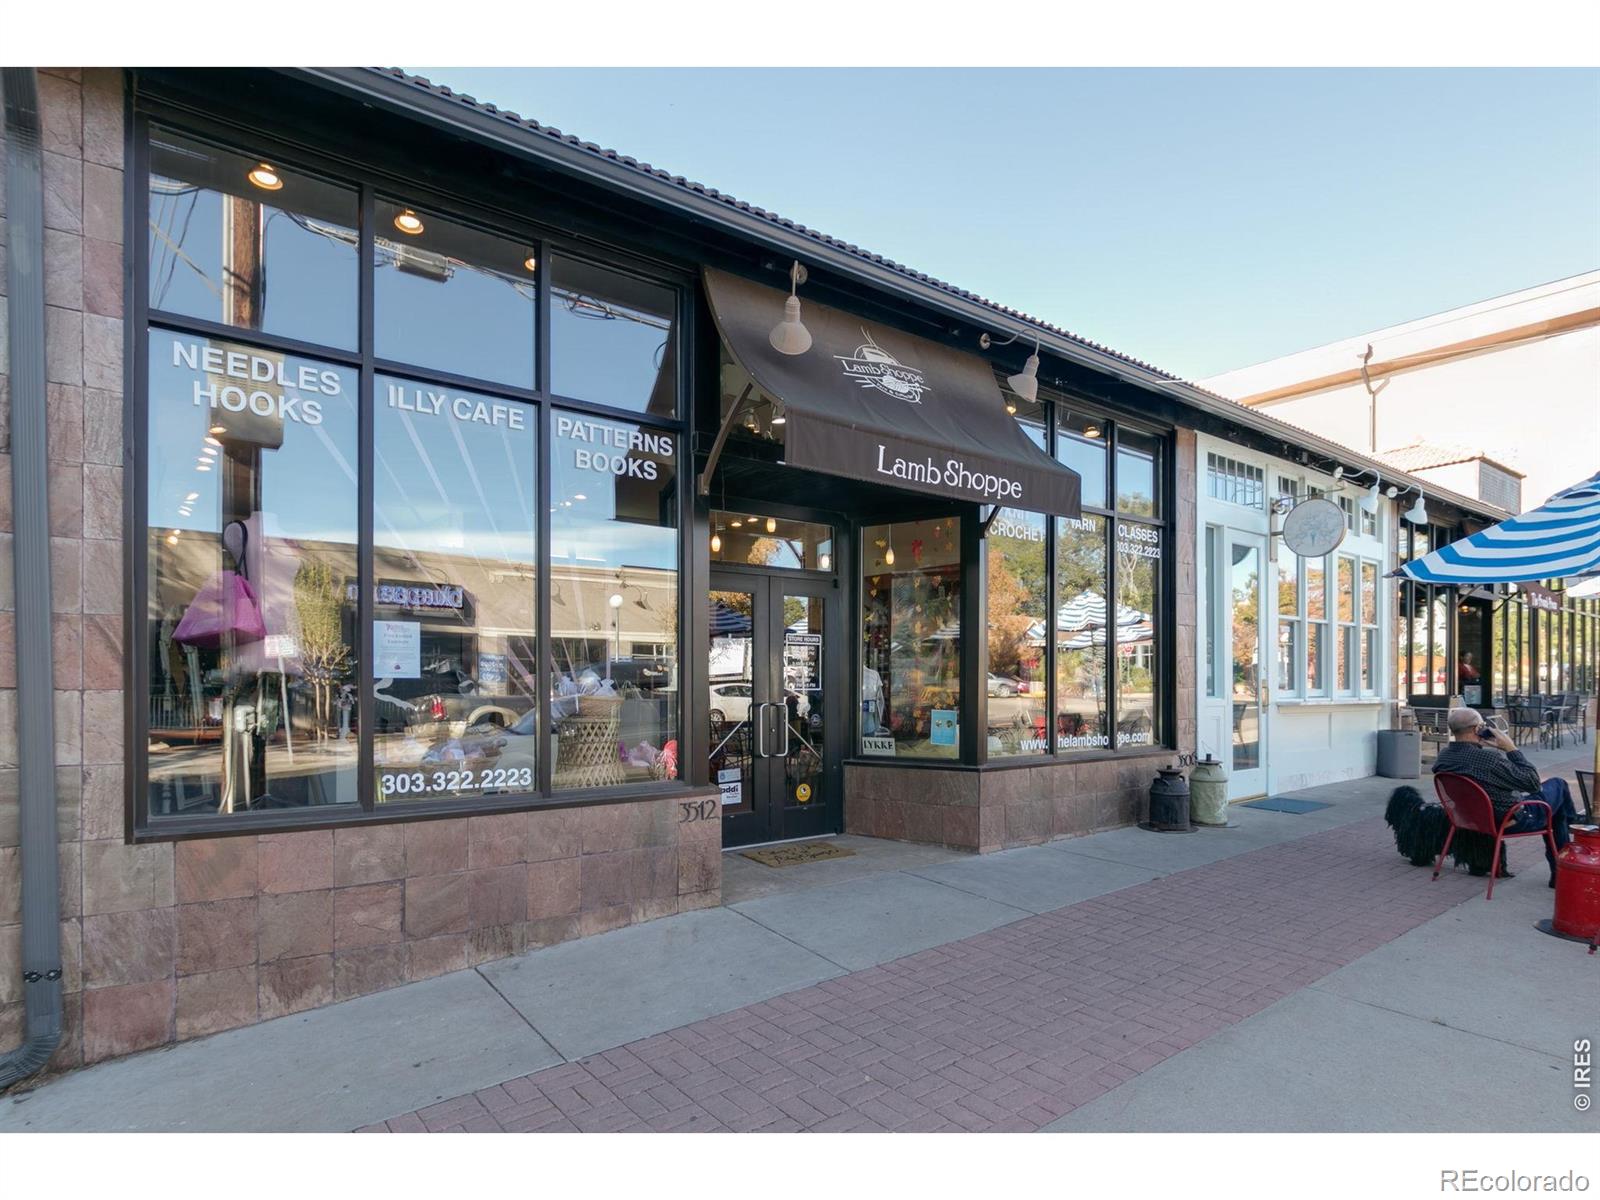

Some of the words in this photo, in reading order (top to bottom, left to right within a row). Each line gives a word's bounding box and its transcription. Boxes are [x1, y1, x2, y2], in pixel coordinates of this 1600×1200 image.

[172, 341, 341, 396] NEEDLES
[193, 381, 323, 425] HOOKS
[388, 385, 447, 415] ILLY
[451, 397, 525, 431] CAFE
[557, 417, 673, 457] PATTERNS
[575, 449, 658, 481] BOOKS
[877, 445, 941, 485] Lamb
[943, 460, 1023, 499] Shoppe
[1118, 524, 1159, 543] CLASSES
[382, 768, 532, 795] 303.322.2223
[680, 799, 721, 823] 3512
